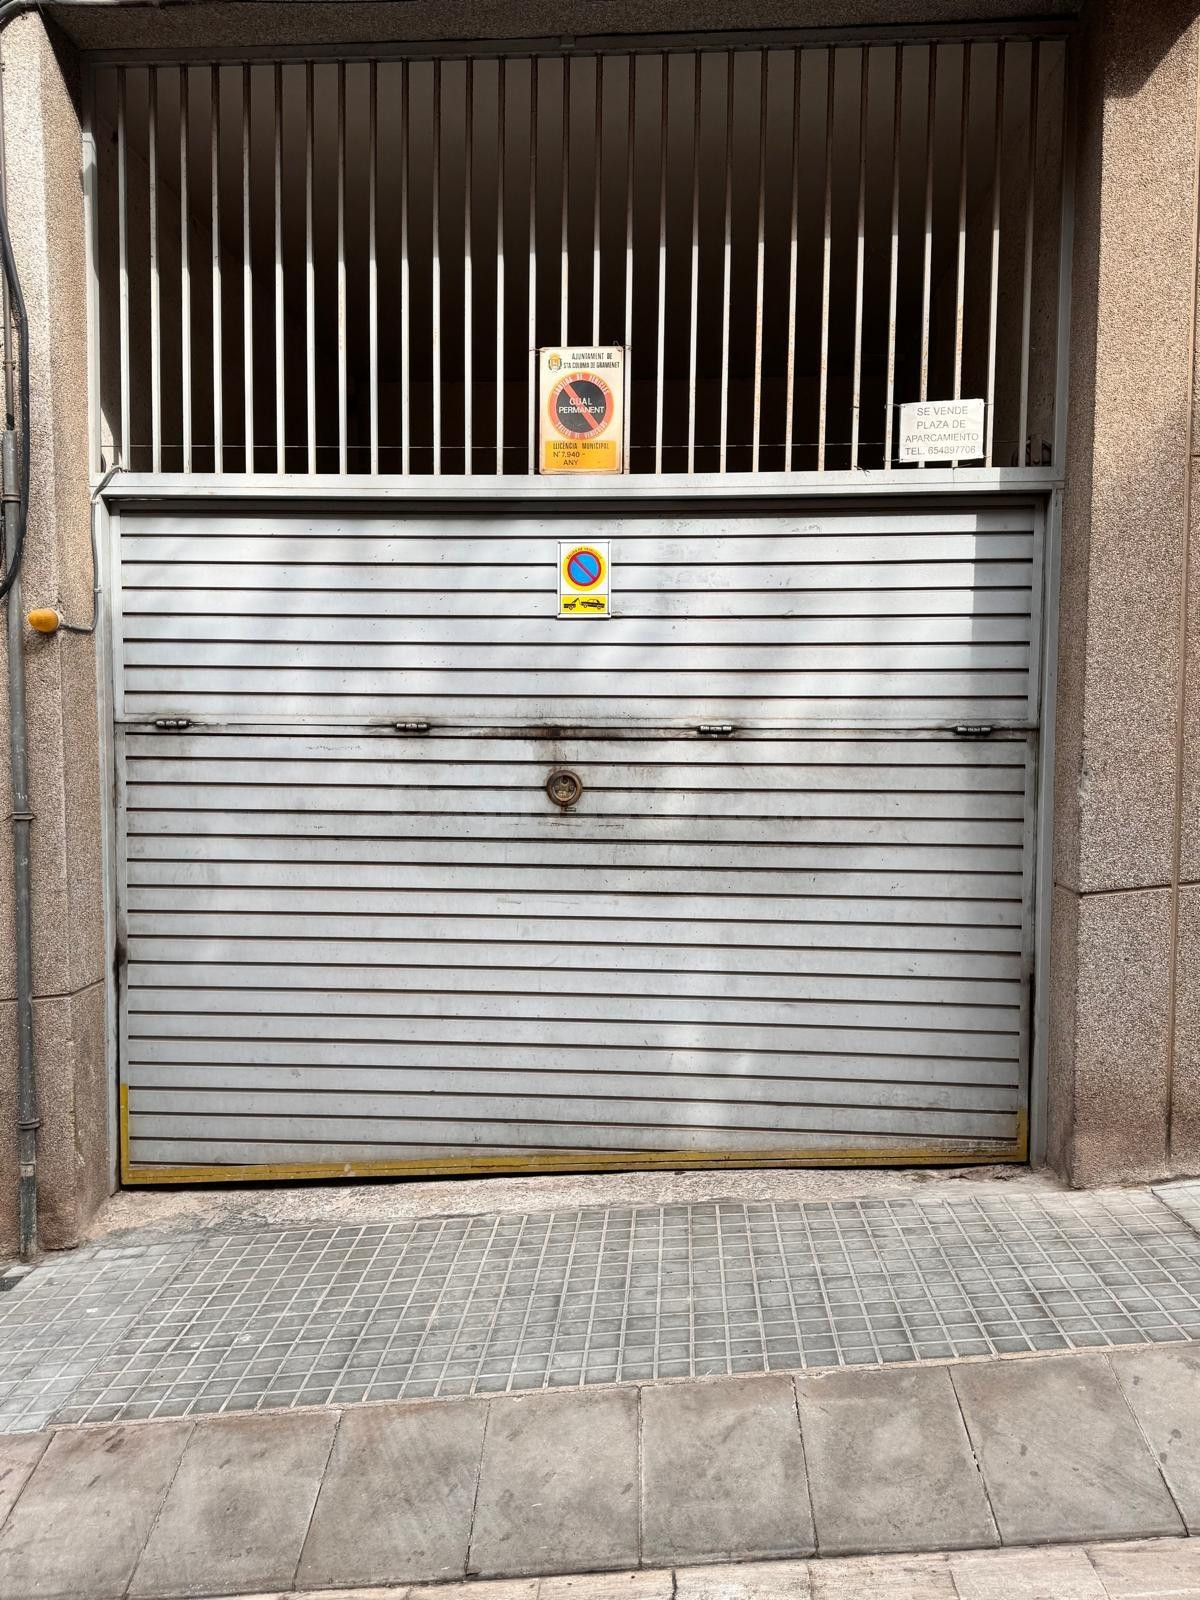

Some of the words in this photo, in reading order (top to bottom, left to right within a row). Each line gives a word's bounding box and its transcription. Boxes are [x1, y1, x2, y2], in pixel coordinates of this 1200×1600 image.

[917, 407, 930, 416] SE
[933, 406, 968, 415] VENDE
[917, 420, 949, 429] PLAZA
[953, 420, 966, 428] DE
[905, 433, 979, 443] APARCAMIENTO
[905, 447, 925, 455] TEL.
